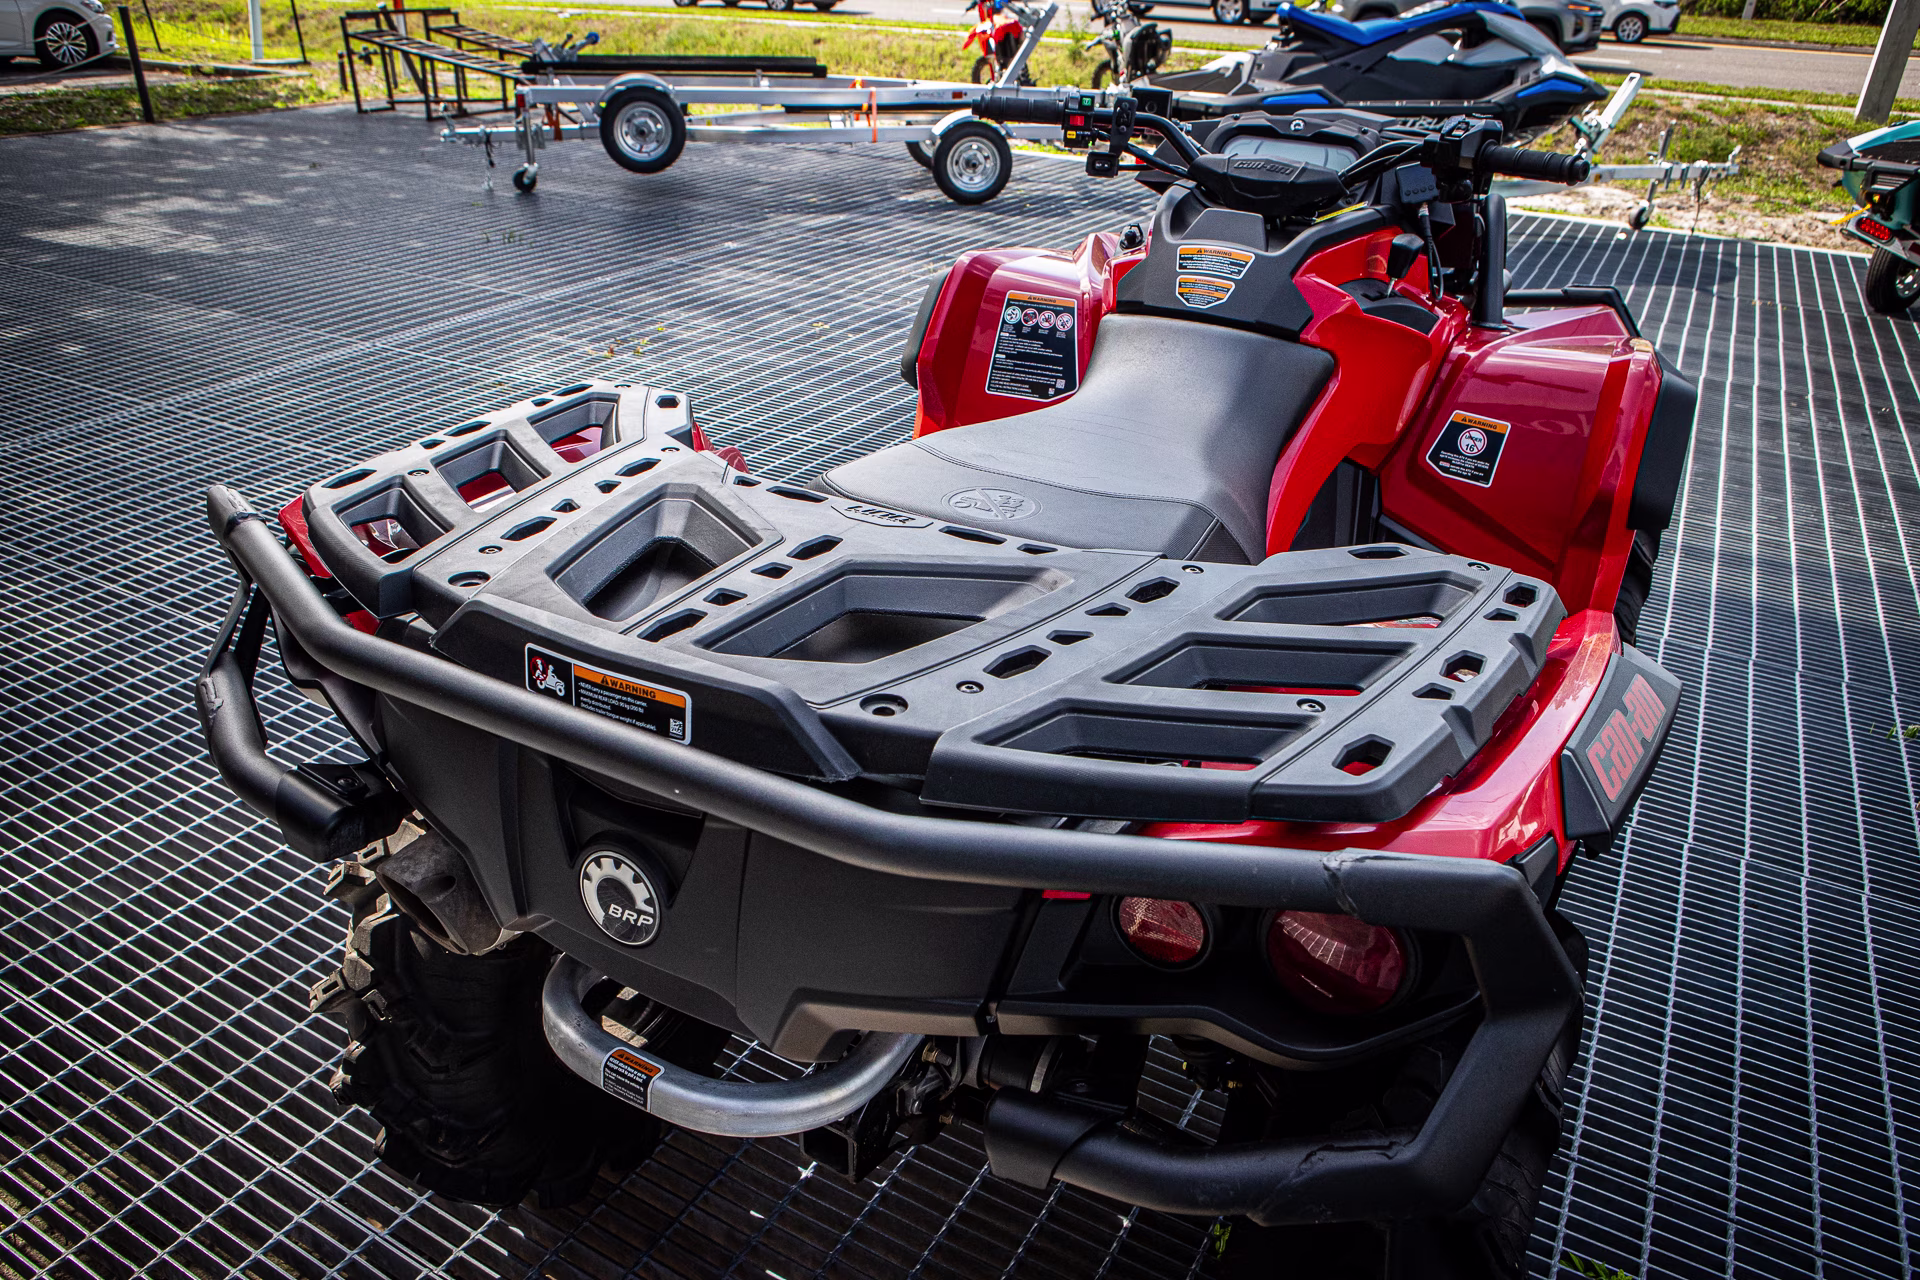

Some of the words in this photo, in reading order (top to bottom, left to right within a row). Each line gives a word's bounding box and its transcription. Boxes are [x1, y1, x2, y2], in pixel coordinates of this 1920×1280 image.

[1204, 249, 1232, 257] WARNING
[1468, 418, 1498, 430] WARNING
[1465, 435, 1482, 443] UNDER
[1466, 444, 1475, 452] 16
[610, 679, 657, 699] WARNING
[608, 904, 654, 926] BRP
[624, 1056, 654, 1072] WARNING
